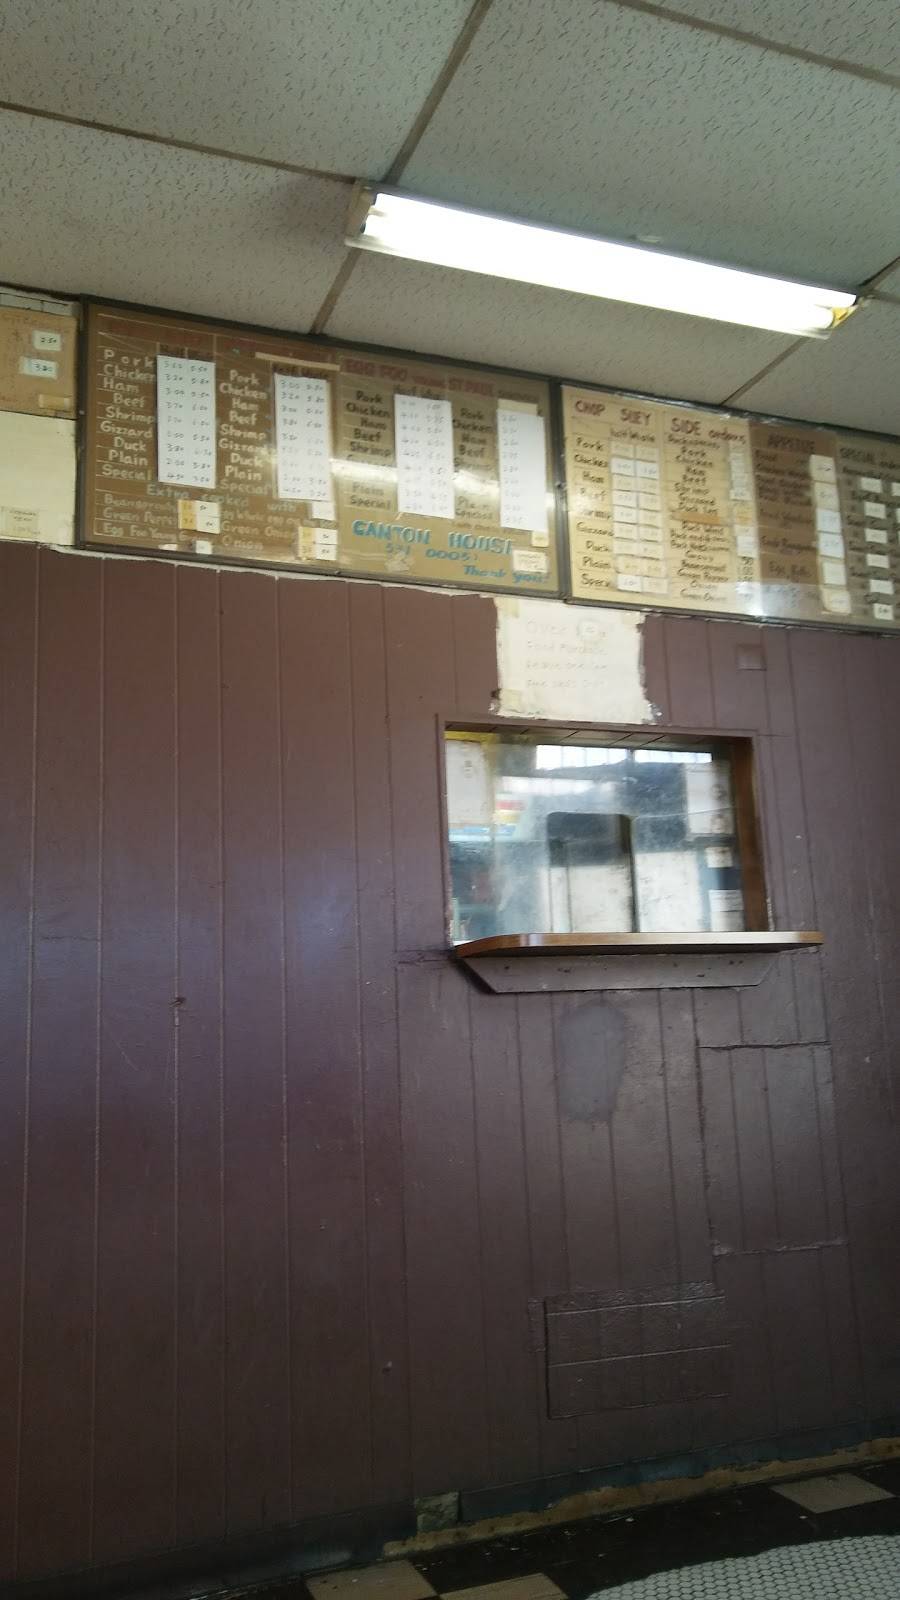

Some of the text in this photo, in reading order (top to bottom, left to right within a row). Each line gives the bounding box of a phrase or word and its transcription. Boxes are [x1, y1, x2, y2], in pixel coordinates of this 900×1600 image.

[104, 349, 155, 367] Pork
[103, 364, 155, 383] Chicken
[229, 369, 260, 385] Pork
[103, 377, 139, 393] Ham
[220, 382, 268, 400] Chicken
[113, 392, 145, 408] Beef
[231, 397, 260, 412] Ham
[356, 390, 383, 404] Pork
[105, 406, 154, 423] Shrimp
[229, 410, 257, 426] Beef
[346, 402, 391, 418] Chicken
[100, 420, 153, 439] Gizzard
[220, 423, 267, 441] Shrimp
[671, 417, 701, 436] SIDE
[353, 428, 381, 442] Beef
[113, 436, 147, 452] Duck
[108, 449, 148, 466] Plain
[230, 452, 264, 468] Duck
[102, 463, 153, 481] Special
[225, 465, 262, 481] Plain
[352, 519, 432, 545] CANTON
[463, 565, 506, 578] Thank
